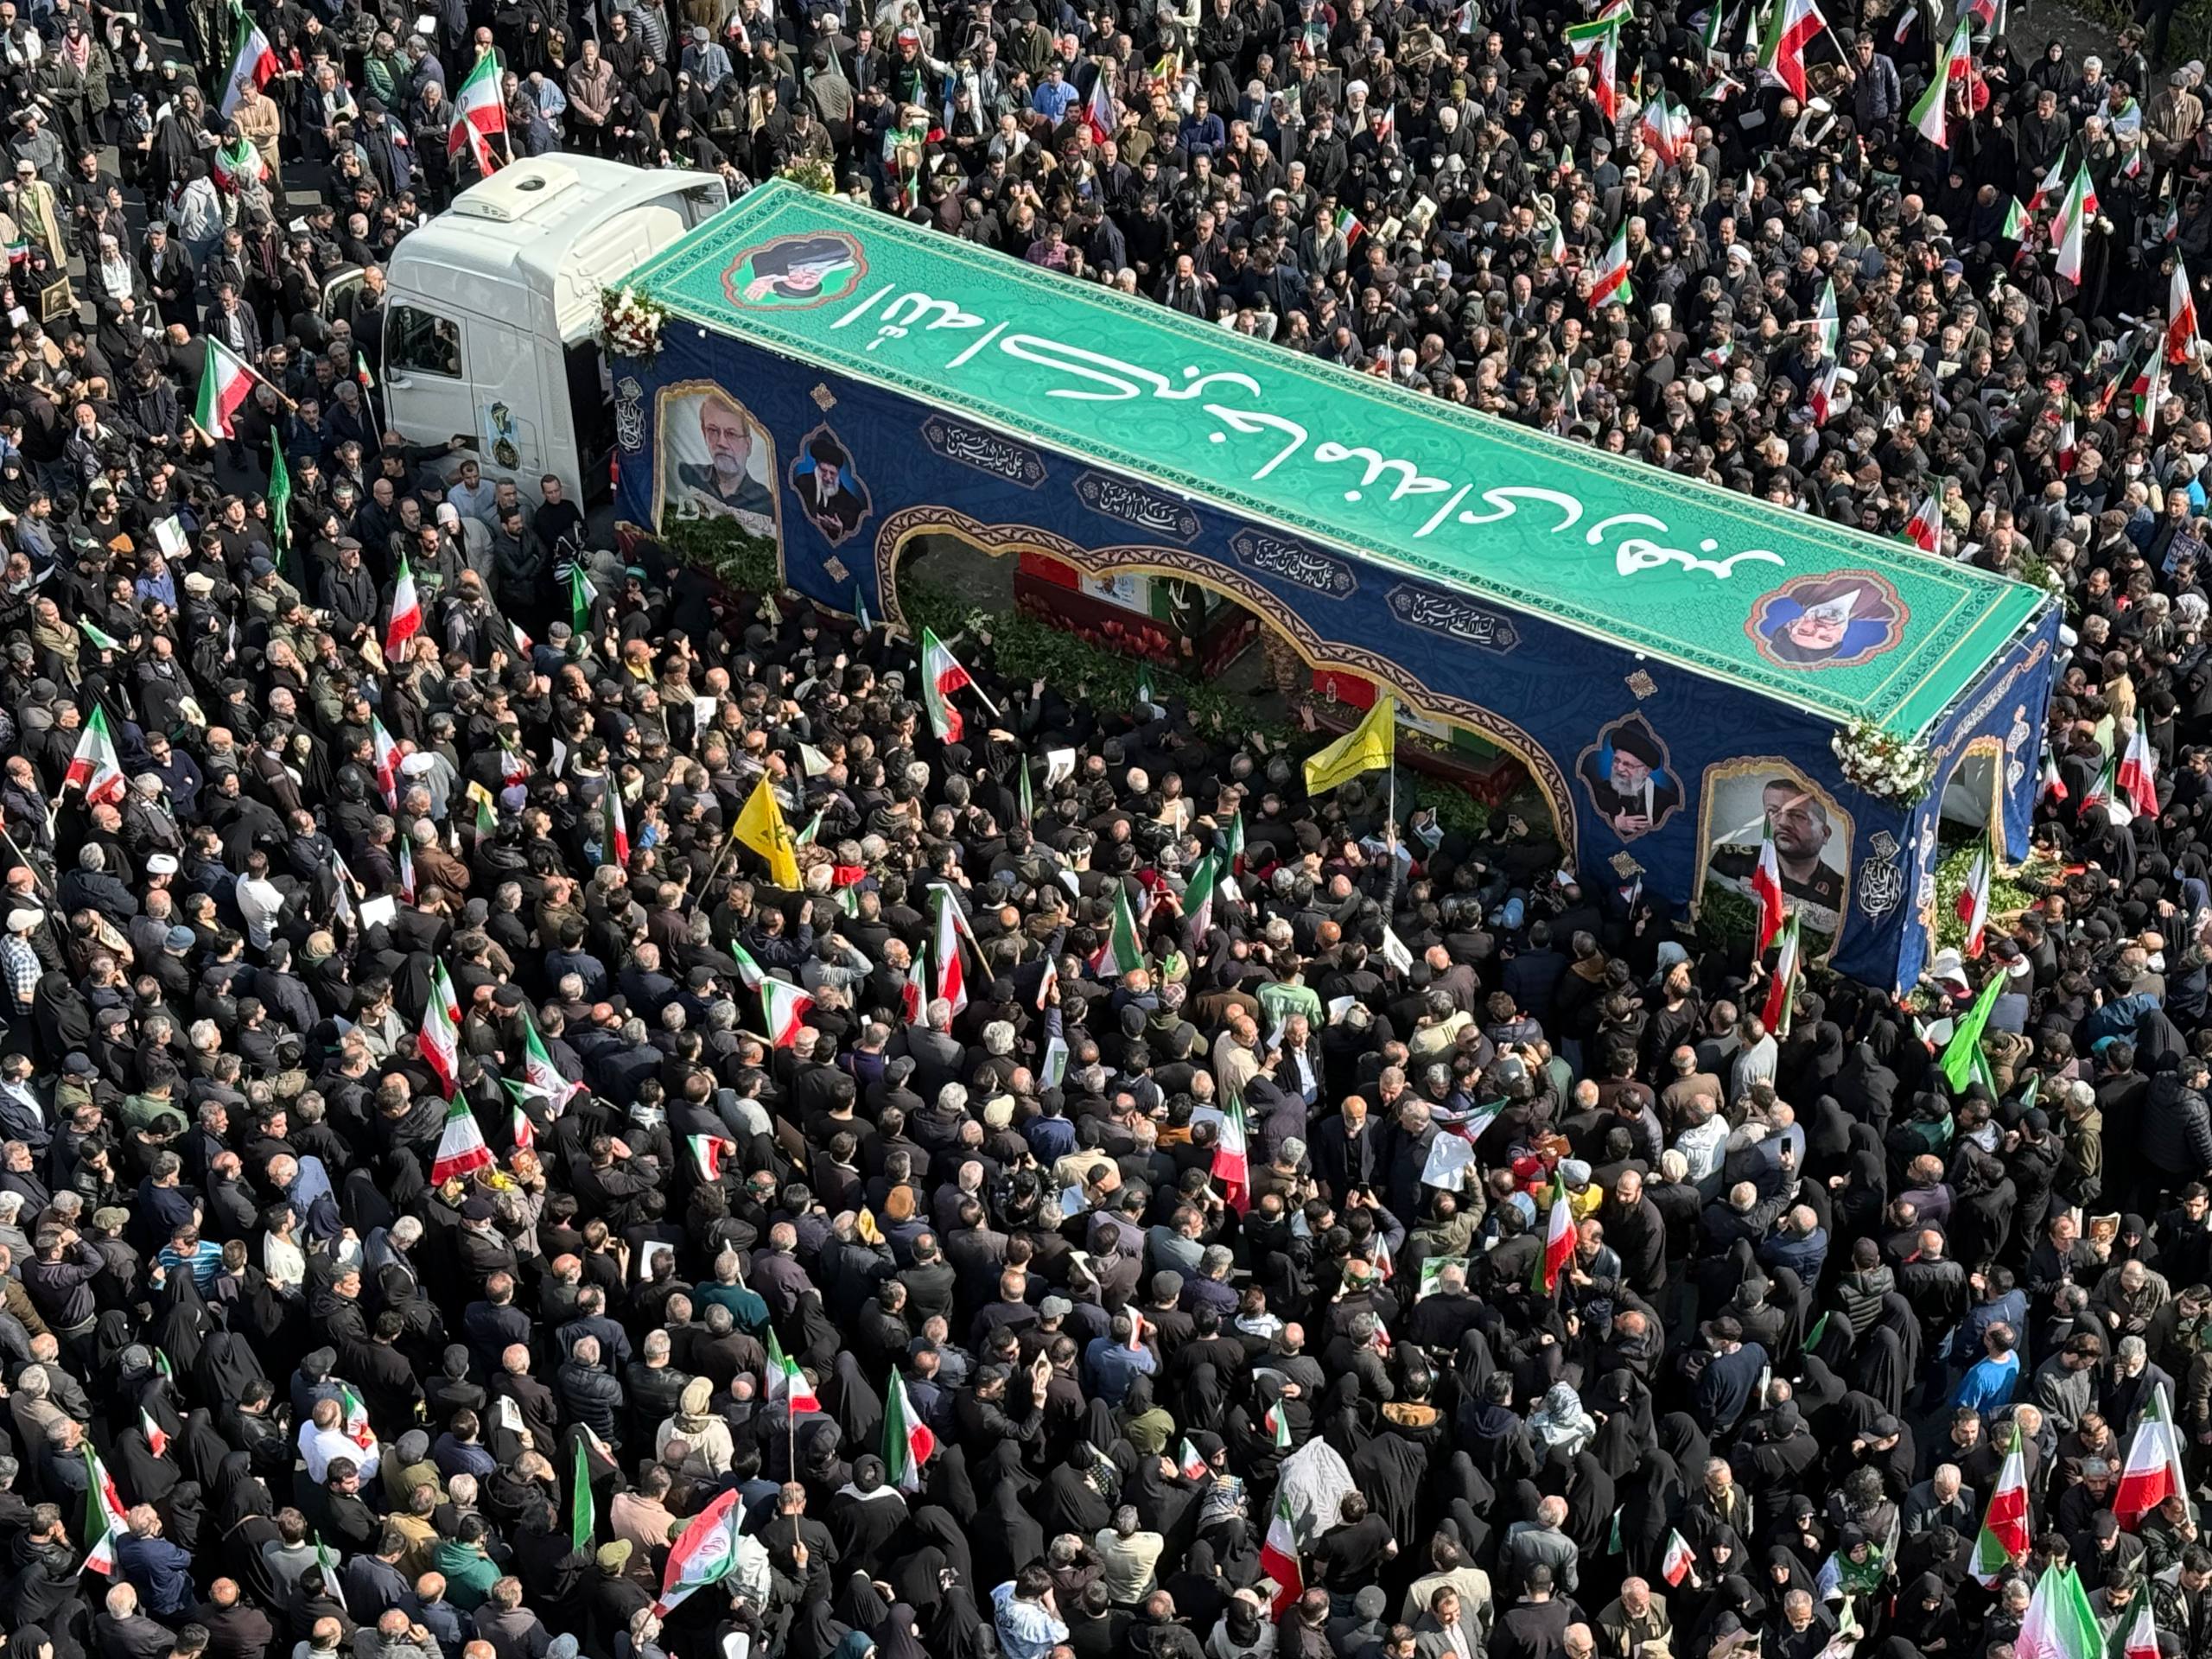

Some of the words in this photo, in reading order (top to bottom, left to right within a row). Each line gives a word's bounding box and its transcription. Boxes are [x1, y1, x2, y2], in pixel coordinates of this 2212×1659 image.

[830, 283, 985, 351] الله
[945, 321, 1262, 401] اکبر
[1586, 512, 1785, 580] رهبر
